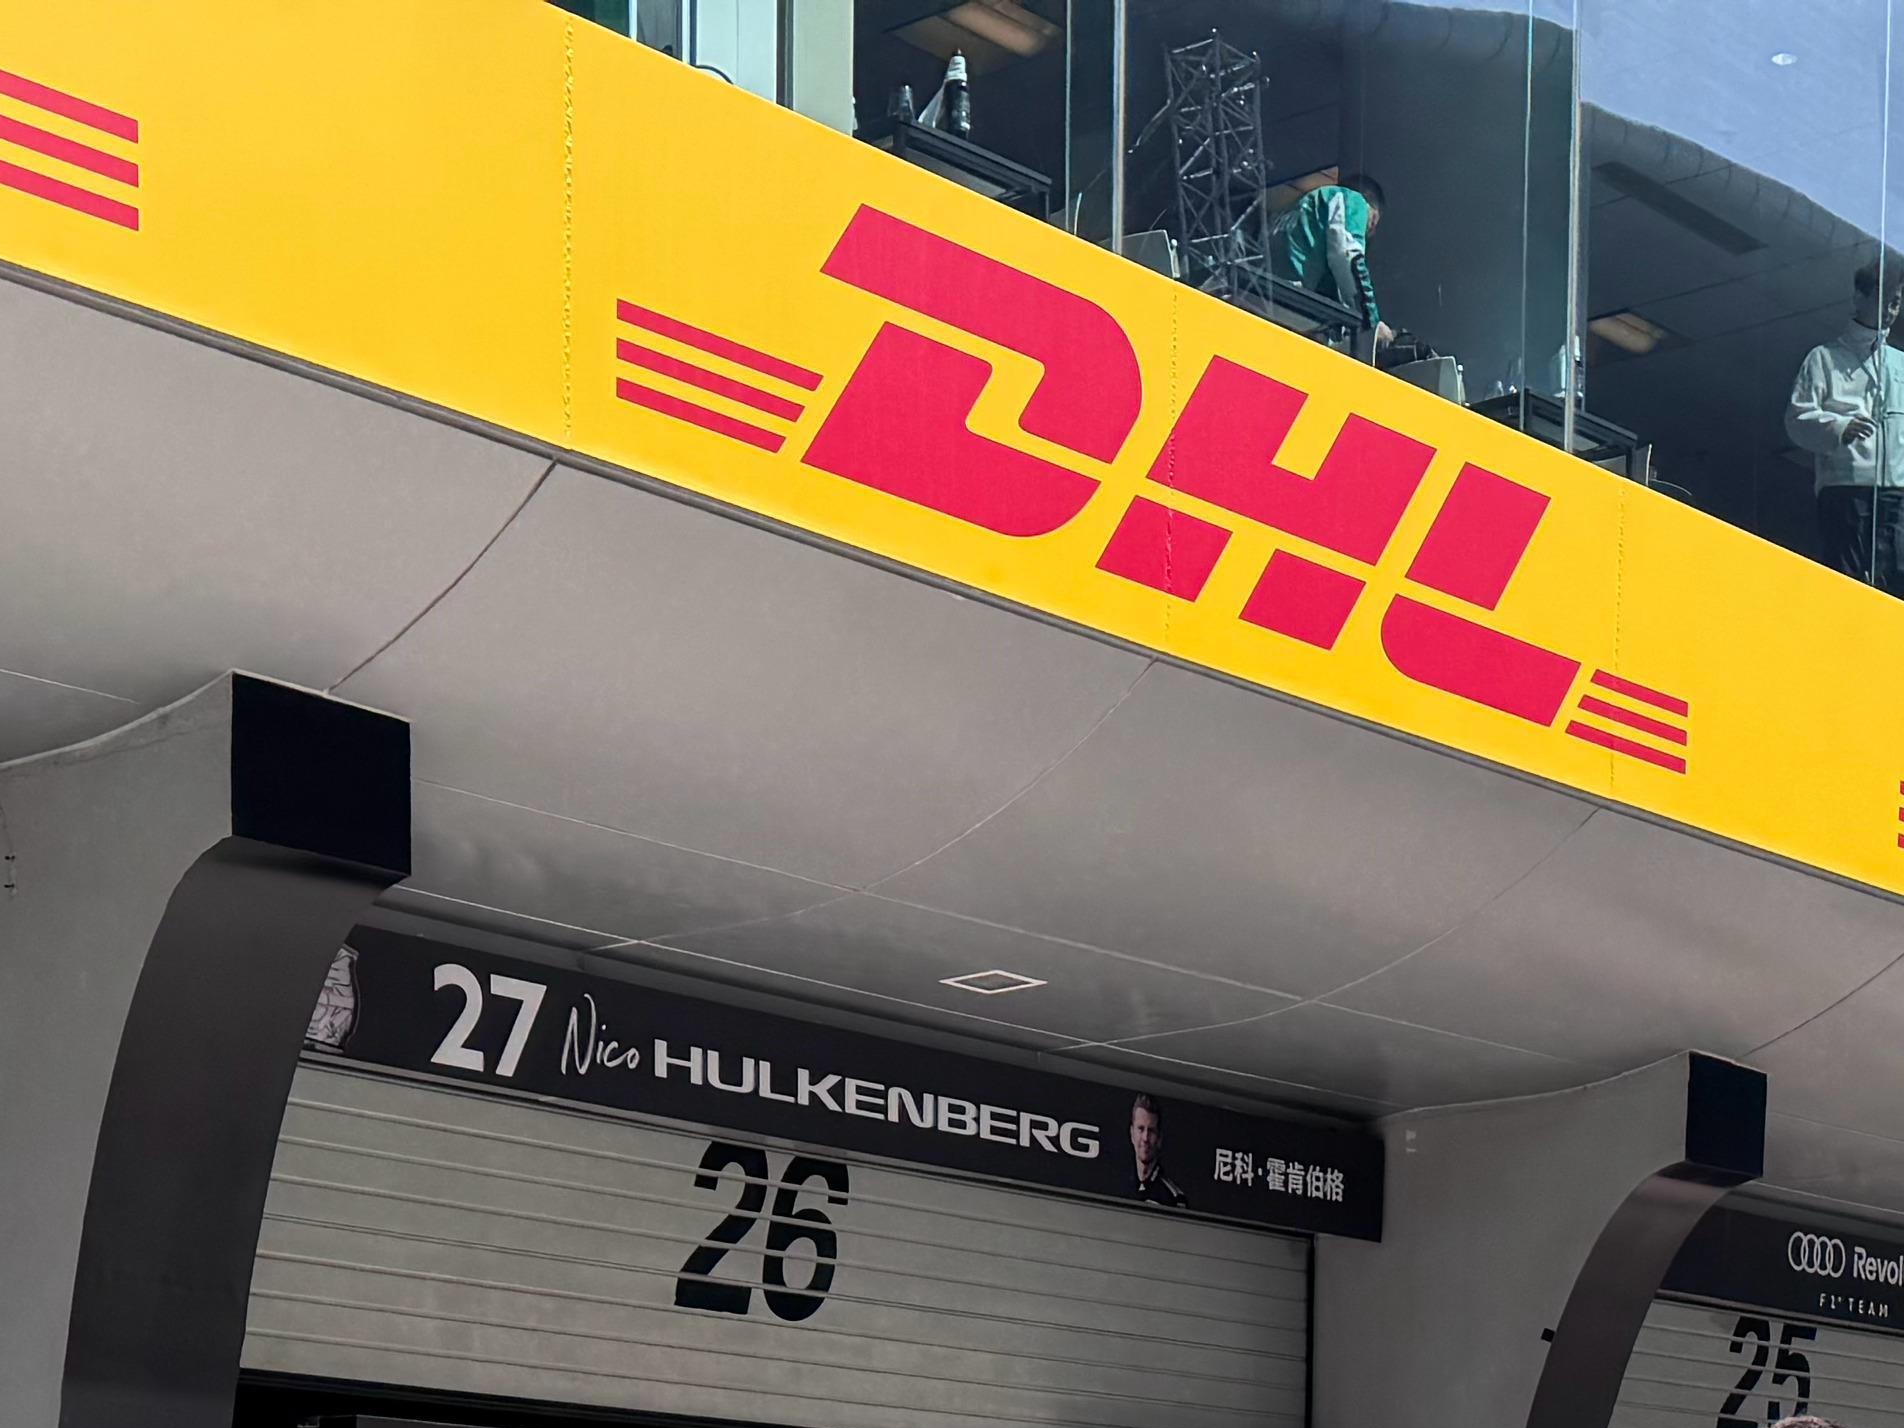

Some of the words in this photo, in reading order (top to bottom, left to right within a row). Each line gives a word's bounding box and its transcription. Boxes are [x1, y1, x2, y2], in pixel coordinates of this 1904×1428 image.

[801, 204, 1581, 728] DHL
[430, 962, 548, 1077] 27
[560, 993, 640, 1077] Nico
[653, 1037, 1101, 1160] HULKENBERG
[674, 1140, 850, 1322] 26
[1848, 1297, 1890, 1318] TEAM
